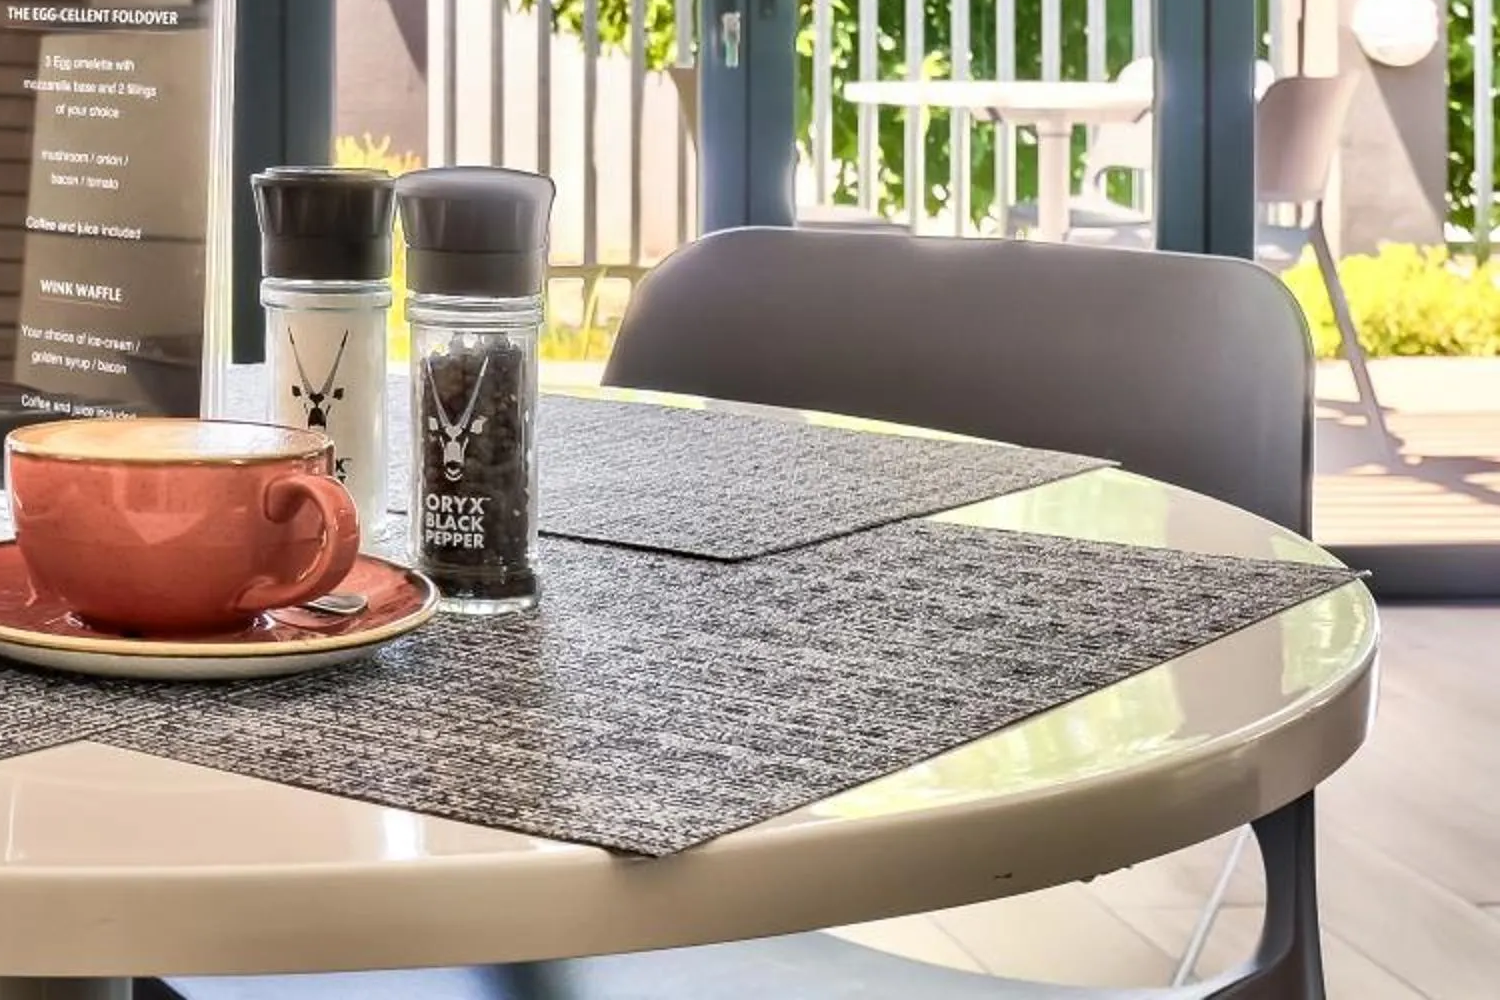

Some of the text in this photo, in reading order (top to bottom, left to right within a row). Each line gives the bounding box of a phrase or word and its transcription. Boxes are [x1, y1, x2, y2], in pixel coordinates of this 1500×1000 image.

[7, 6, 178, 25] THE EGG-CELLENT FOLDOVER
[54, 56, 71, 71] Egg
[116, 59, 135, 71] with
[99, 83, 117, 94] and
[56, 104, 120, 119] of your choice
[41, 150, 89, 163] mushroom
[96, 154, 123, 166] onion
[51, 173, 79, 185] bacon
[87, 176, 120, 190] tomato
[25, 215, 142, 240] Coffee and juice included
[40, 279, 123, 302] WINK WAFFLE
[21, 325, 43, 339] Your
[44, 328, 74, 343] choice
[76, 332, 86, 345] of
[31, 350, 63, 365] golden
[65, 356, 90, 372] syrup
[98, 360, 127, 375] bacon
[21, 394, 51, 411] Coffee
[53, 400, 71, 413] and
[426, 493, 484, 515] ORYX
[426, 511, 484, 532] BLACK
[425, 529, 484, 549] PEPPER
